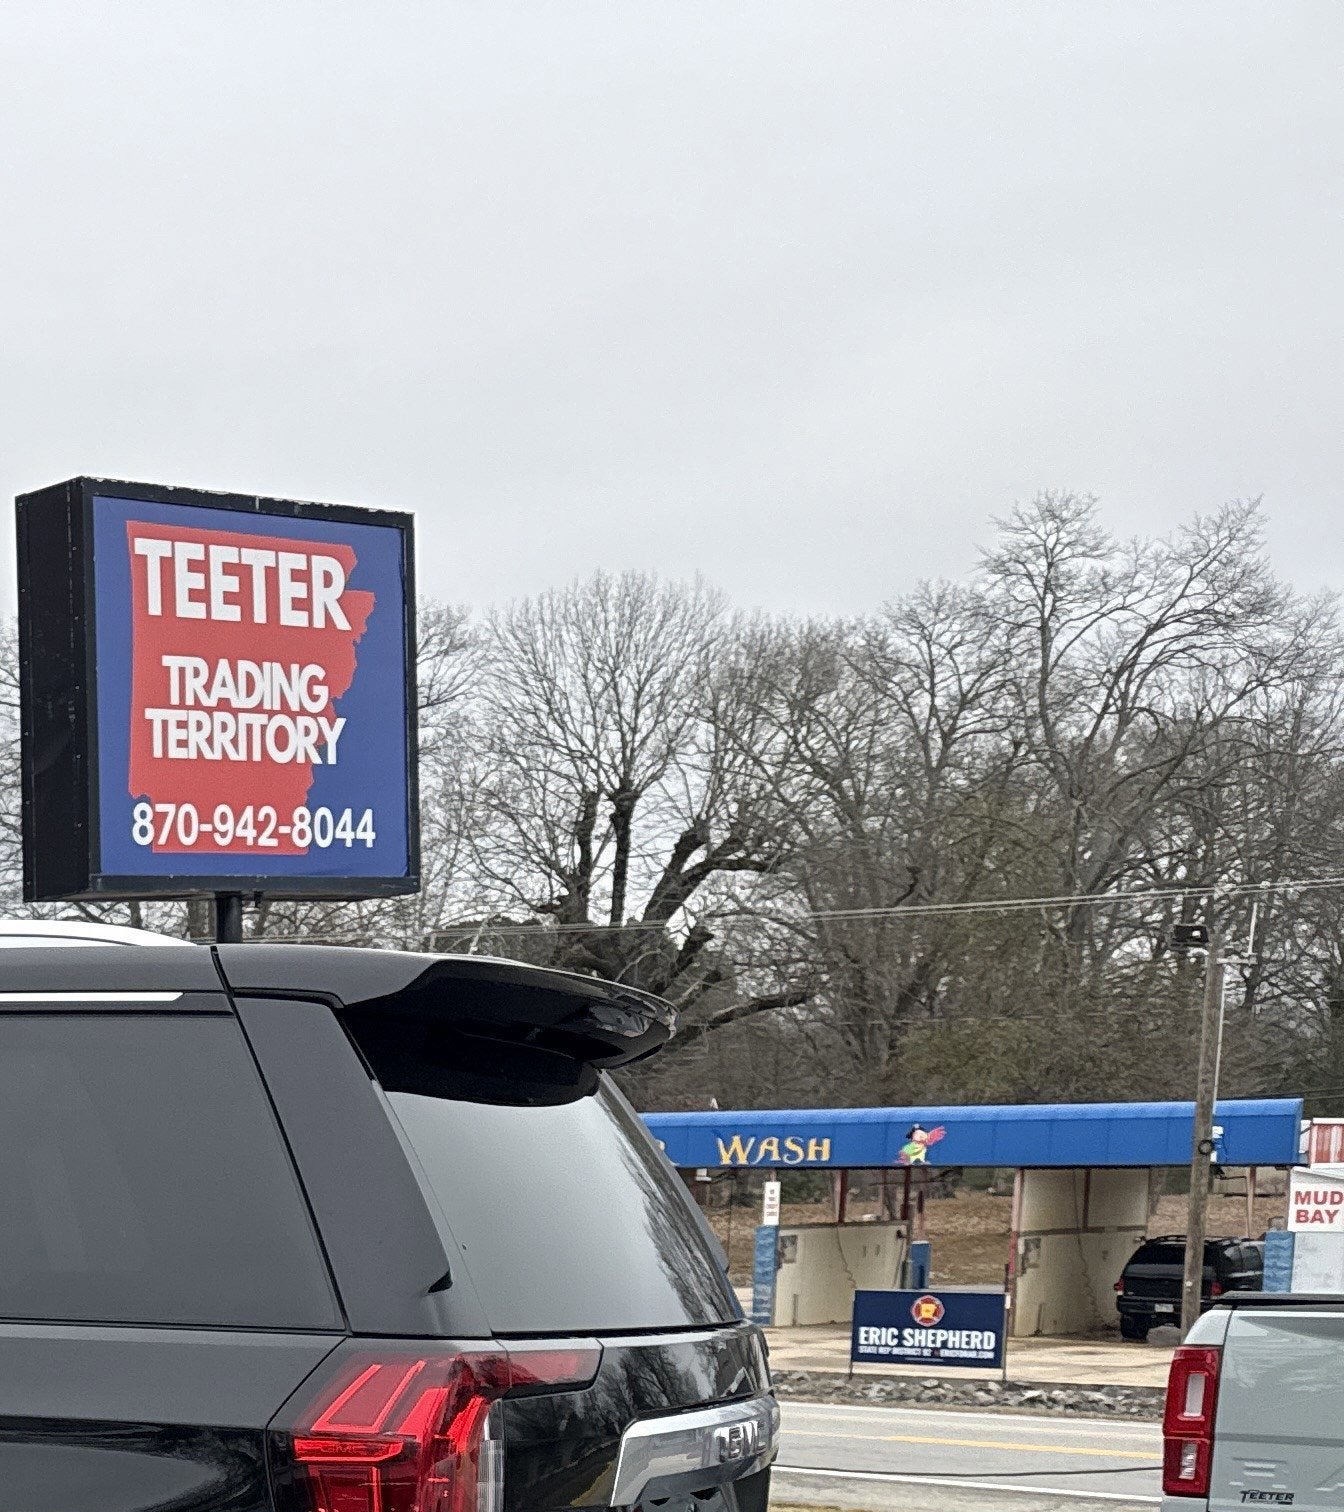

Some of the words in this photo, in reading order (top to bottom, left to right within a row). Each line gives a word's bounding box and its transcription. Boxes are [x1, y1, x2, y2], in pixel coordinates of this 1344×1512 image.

[134, 537, 351, 630] TEETER
[162, 655, 329, 713] TRADING
[145, 708, 347, 765] TERRITORY
[132, 802, 375, 848] 870-942-8044
[716, 1135, 831, 1165] WASH
[1295, 1190, 1344, 1205] MUD
[1296, 1209, 1340, 1223] BAY
[858, 1326, 899, 1346] ERIC
[902, 1327, 996, 1350] SHEPHERD
[1240, 1490, 1295, 1504] TEETER
